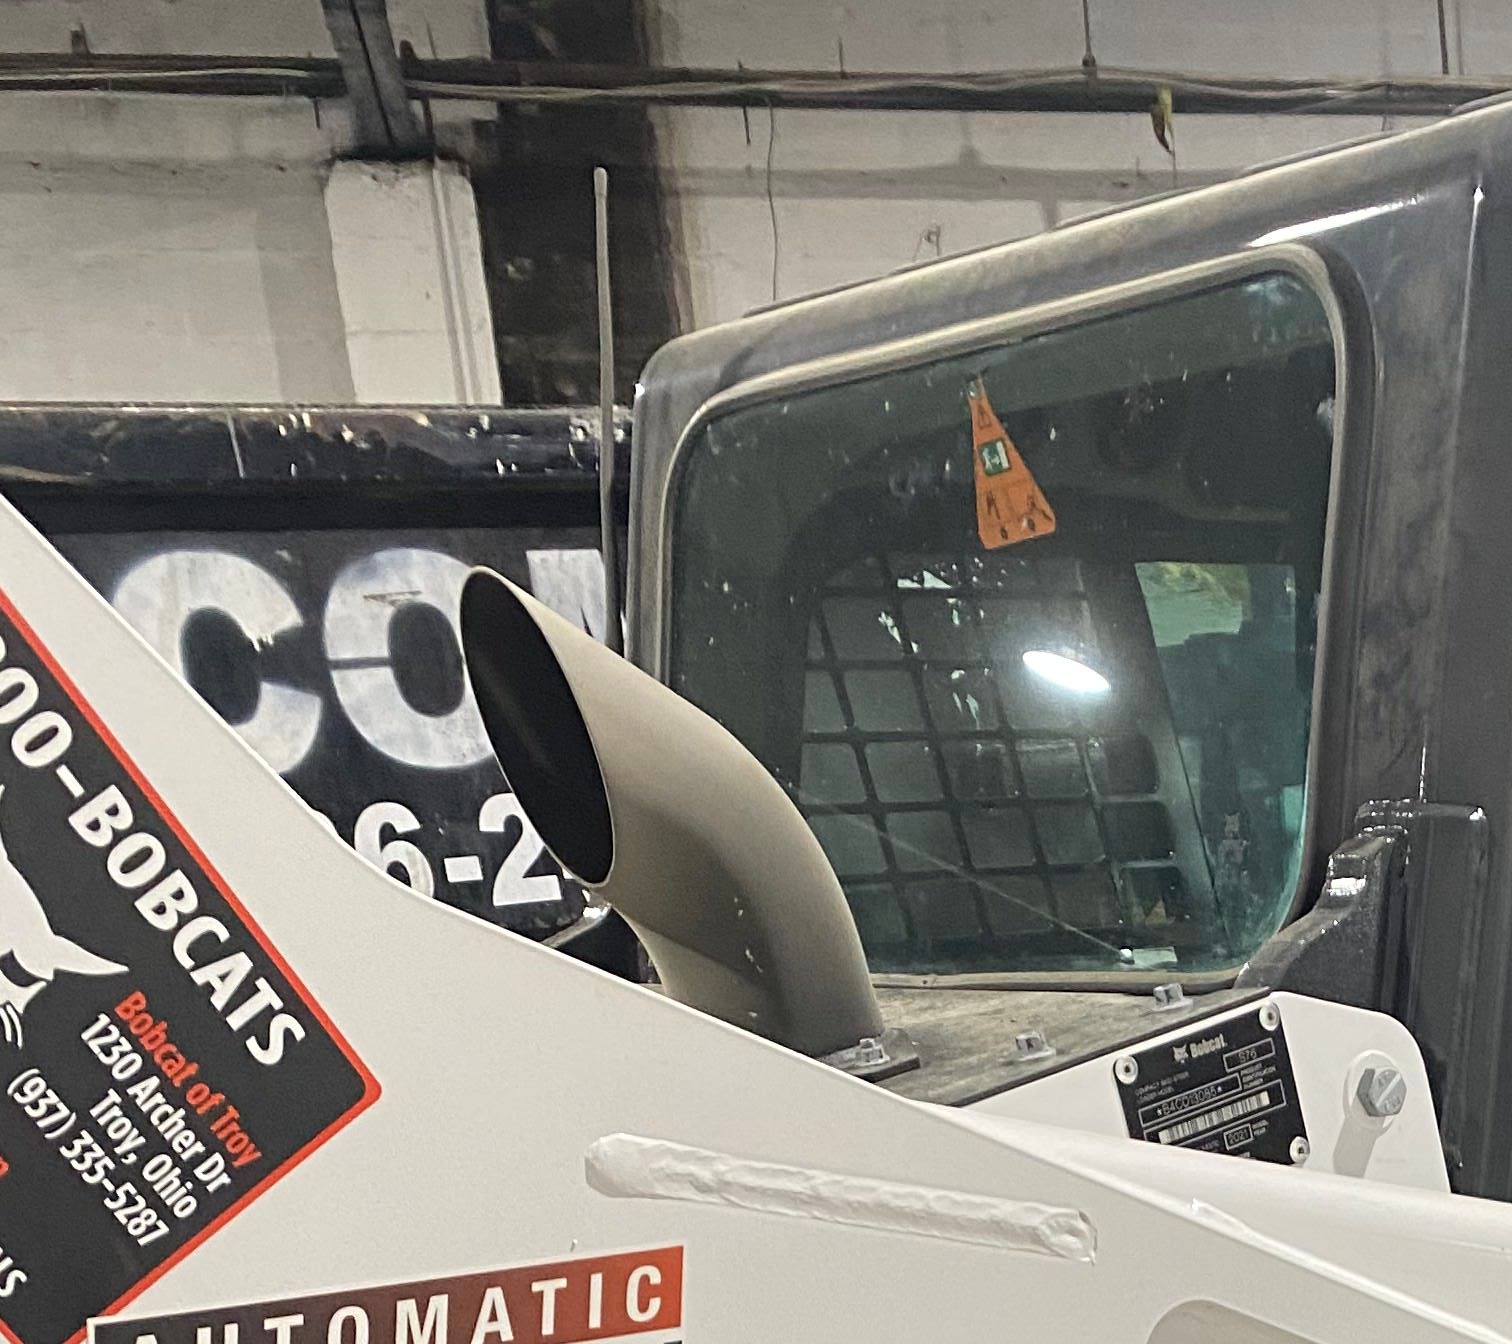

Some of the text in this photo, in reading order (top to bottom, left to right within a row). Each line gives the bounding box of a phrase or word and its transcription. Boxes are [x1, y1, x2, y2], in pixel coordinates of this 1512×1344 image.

[0, 632, 306, 1067] 00-BOBCATS
[81, 1013, 232, 1194] 1230 Archer Dr
[114, 991, 263, 1169] Bobcat of Troy
[1189, 1033, 1228, 1059] Bobcat
[7, 1068, 171, 1247] (937) 335-5287
[89, 1088, 199, 1219] Troy, Ohio
[1227, 1128, 1250, 1145] 2021
